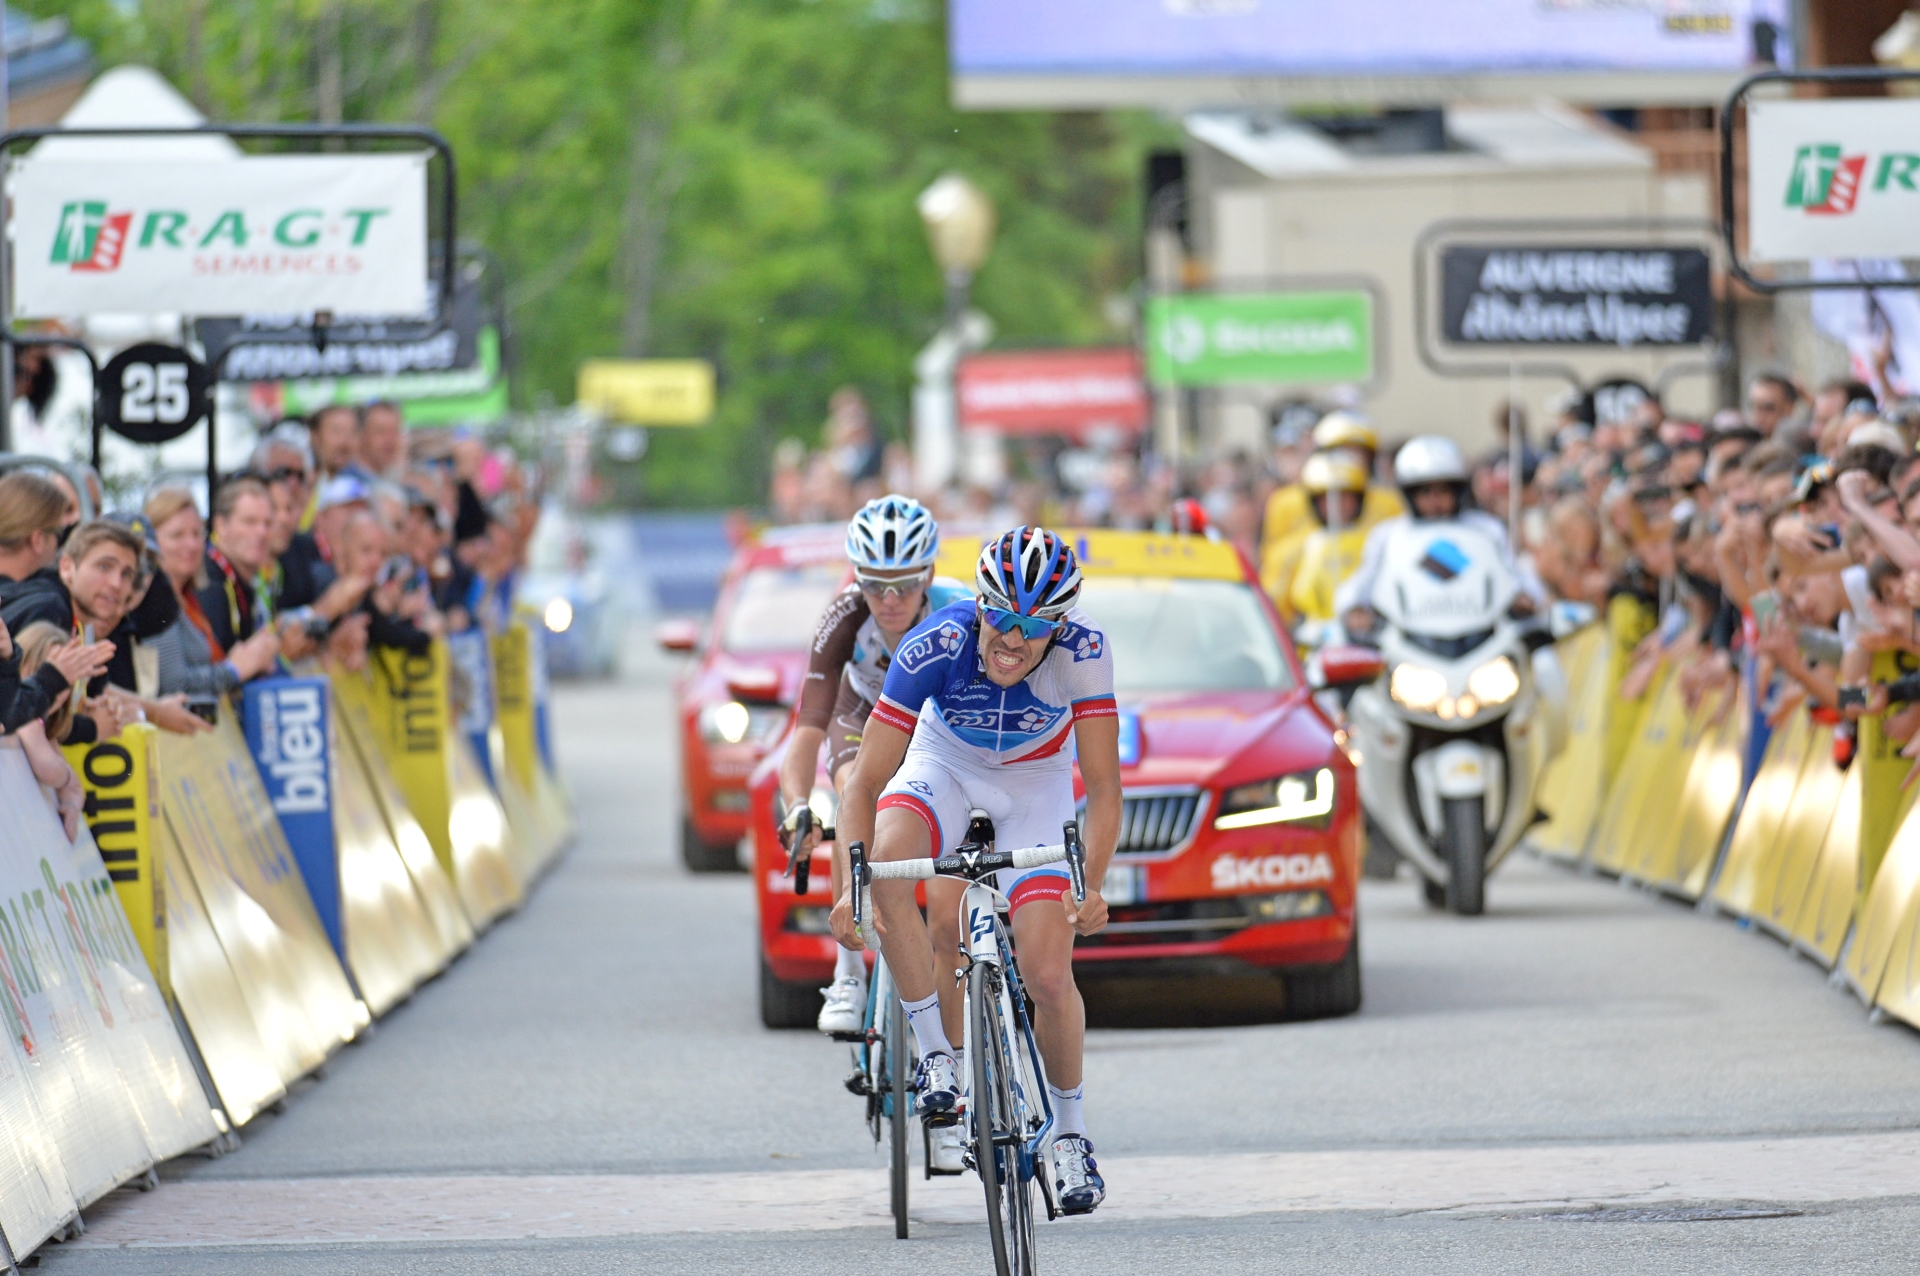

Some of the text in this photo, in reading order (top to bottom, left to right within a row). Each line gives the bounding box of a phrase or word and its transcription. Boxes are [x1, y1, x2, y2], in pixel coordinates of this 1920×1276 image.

[192, 252, 363, 276] SEMENCES
[1479, 251, 1676, 294] AUVERGNE
[120, 361, 190, 424] 25
[988, 591, 1009, 608] BBB
[1037, 606, 1062, 616] BBB
[814, 600, 858, 654] MONDIALE
[903, 636, 934, 666] FDJ
[403, 652, 439, 753] info
[872, 707, 912, 730] APIERRE
[946, 714, 998, 727] FDJ
[272, 687, 328, 813] bleu
[82, 742, 141, 883] info
[1014, 888, 1063, 905] LAPIERRE
